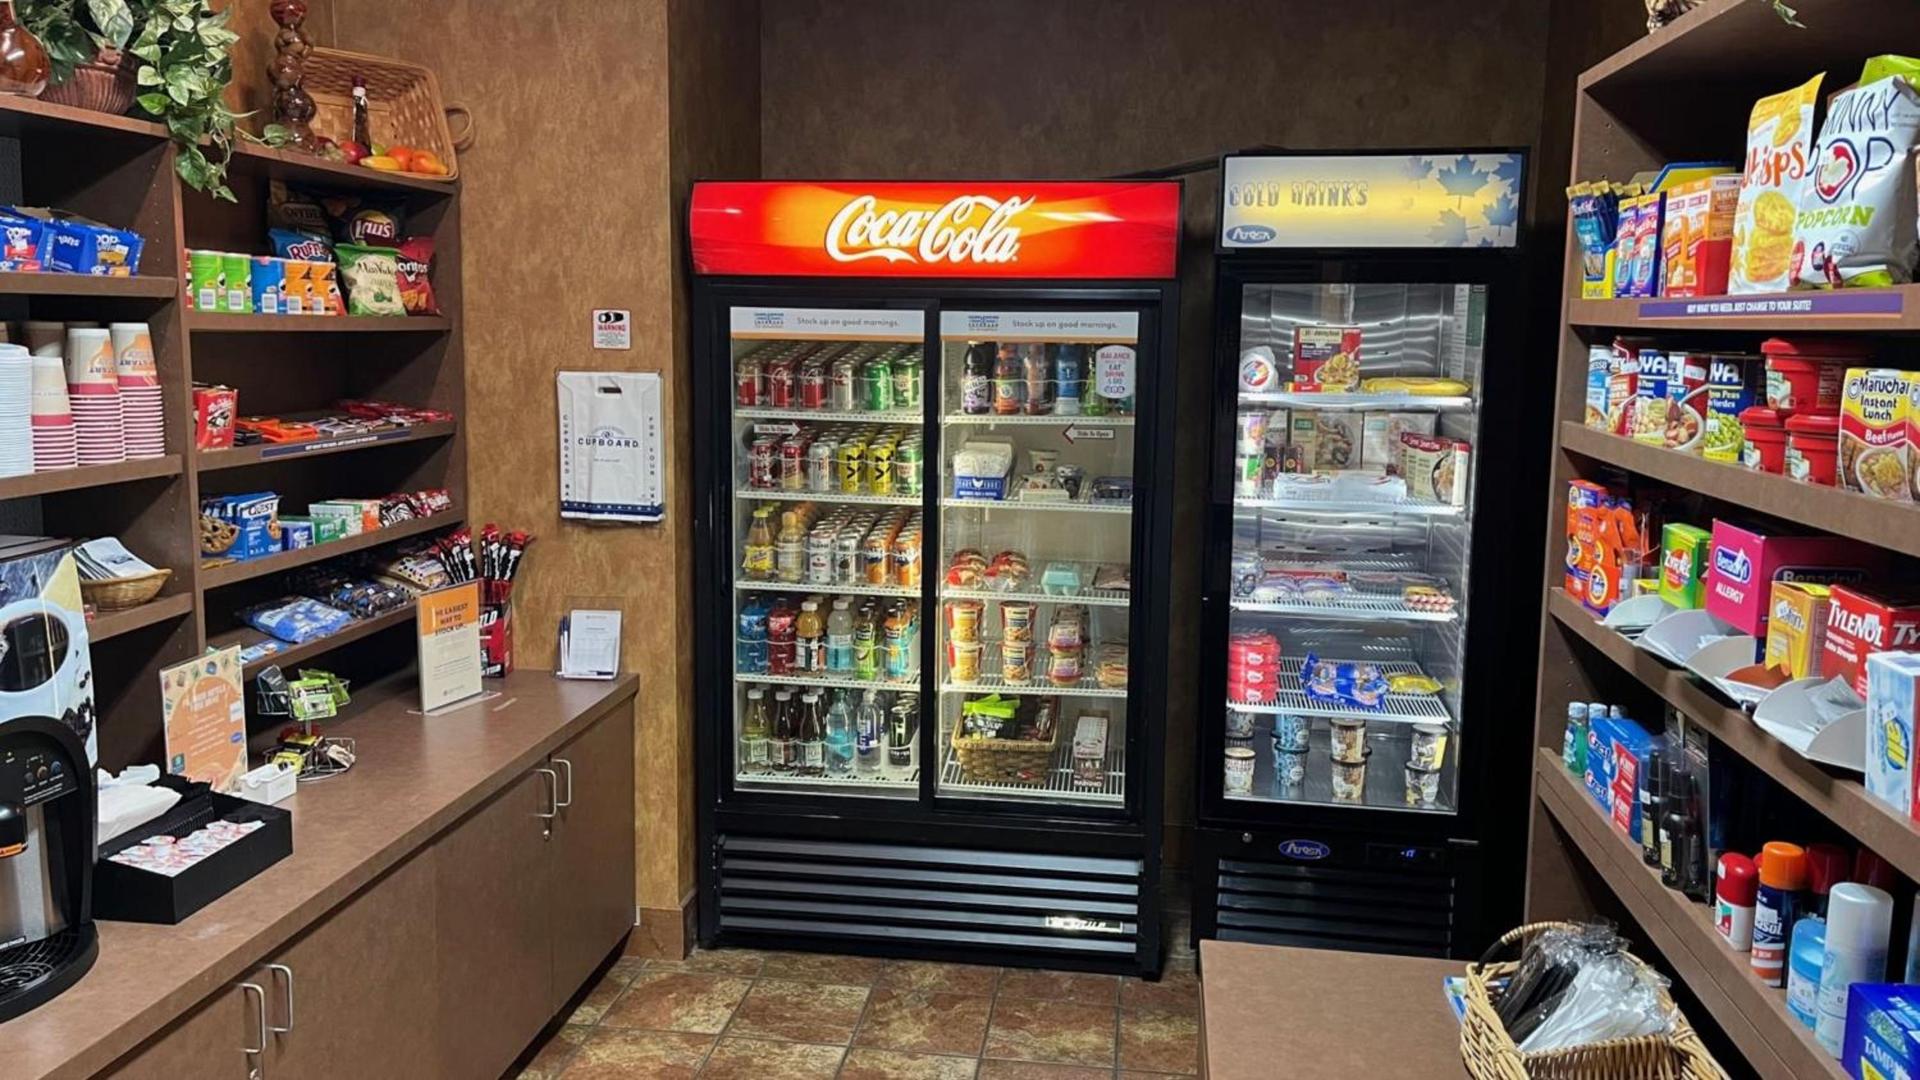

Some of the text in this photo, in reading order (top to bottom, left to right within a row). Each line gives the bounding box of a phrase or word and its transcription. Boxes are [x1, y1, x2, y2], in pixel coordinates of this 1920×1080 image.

[1229, 180, 1369, 207] COLD DRINKS
[1796, 204, 1876, 231] POPCORN
[825, 194, 1037, 264] Coca-Cola
[396, 261, 429, 274] oritos
[841, 318, 861, 327] good
[1059, 320, 1079, 330] good
[1638, 354, 1668, 374] YA
[1710, 362, 1740, 383] YA
[1860, 395, 1898, 409] Instant
[1863, 408, 1893, 421] Lunch
[578, 437, 640, 449] CUPBOARD
[1865, 429, 1887, 444] Beef
[1715, 582, 1745, 605] ALLERGY
[1827, 598, 1885, 648] TYLENOL
